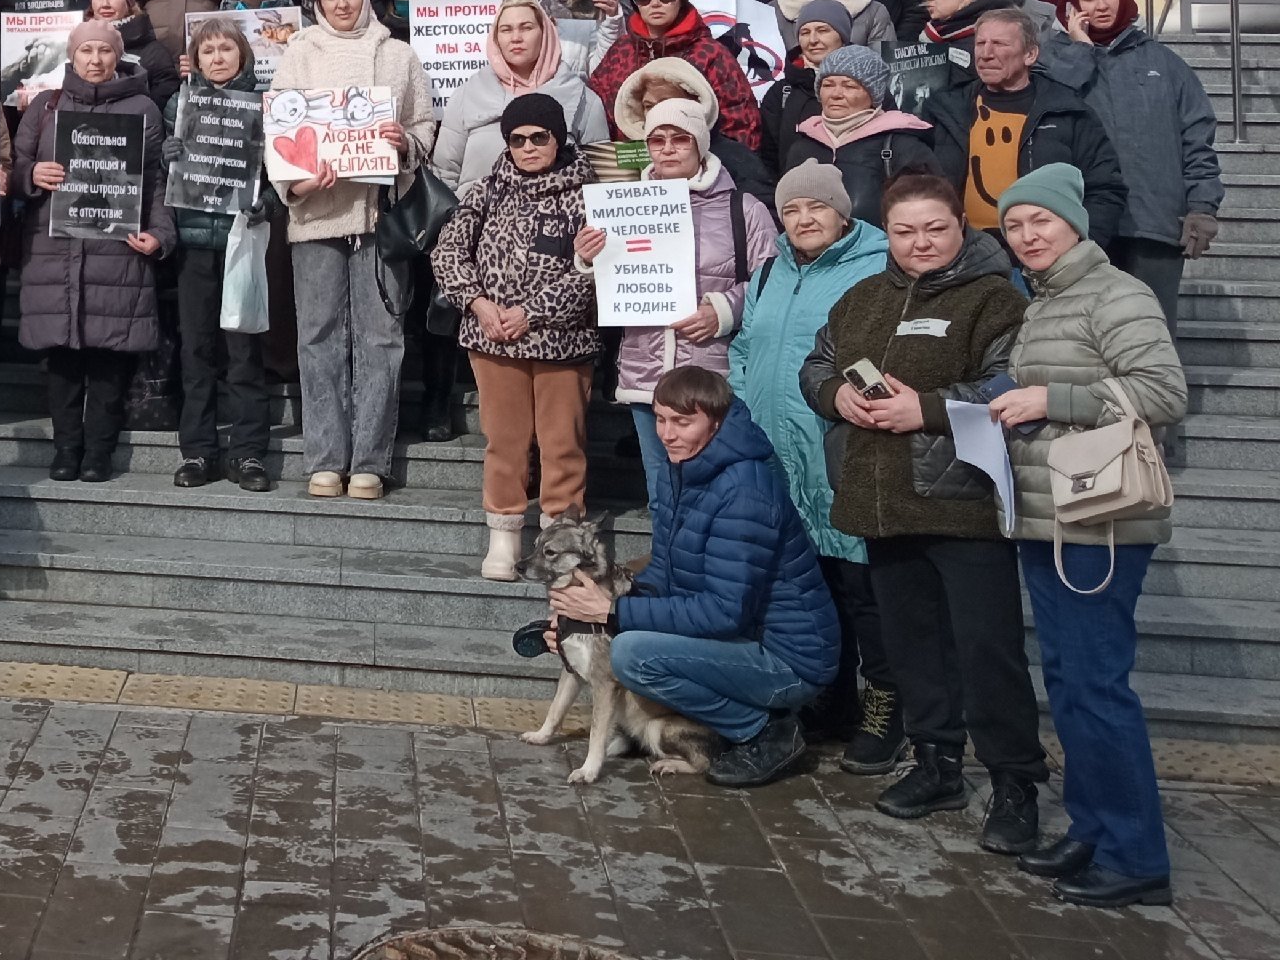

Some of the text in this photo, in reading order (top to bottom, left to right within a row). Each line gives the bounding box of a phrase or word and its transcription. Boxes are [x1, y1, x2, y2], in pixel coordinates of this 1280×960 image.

[416, 4, 497, 18] МЫ ПРОТИВ
[6, 16, 74, 26] МЫ ПРОТИВ
[414, 23, 492, 36] ЖЕСТОКОСТ
[436, 42, 482, 54] МЫ ЗА
[422, 60, 489, 71] ФФЕКТИВН
[188, 90, 212, 107] Запрет
[212, 97, 222, 106] на
[200, 114, 220, 126] собак
[72, 129, 127, 146] Обязательная
[196, 134, 243, 148] состоящим на
[322, 128, 383, 144] ЛЮБИТ
[340, 142, 374, 155] А НЕ
[70, 158, 126, 174] регистрация и
[188, 154, 246, 168] психиатрическом
[183, 172, 246, 188] и наркологическом
[90, 184, 126, 198] штрафы
[127, 186, 138, 195] за
[606, 186, 668, 200] УБИВАТЬ
[203, 195, 222, 205] учете
[68, 207, 123, 219] ее отсутствие
[592, 203, 687, 219] МИЛОСЕРДИЕ
[612, 222, 680, 236] ЧЕЛОВЕКЕ
[614, 264, 674, 274] УБИВАТЬ
[616, 282, 672, 294] ЛЮБОВЬ
[614, 302, 676, 314] К РОДИНЕ
